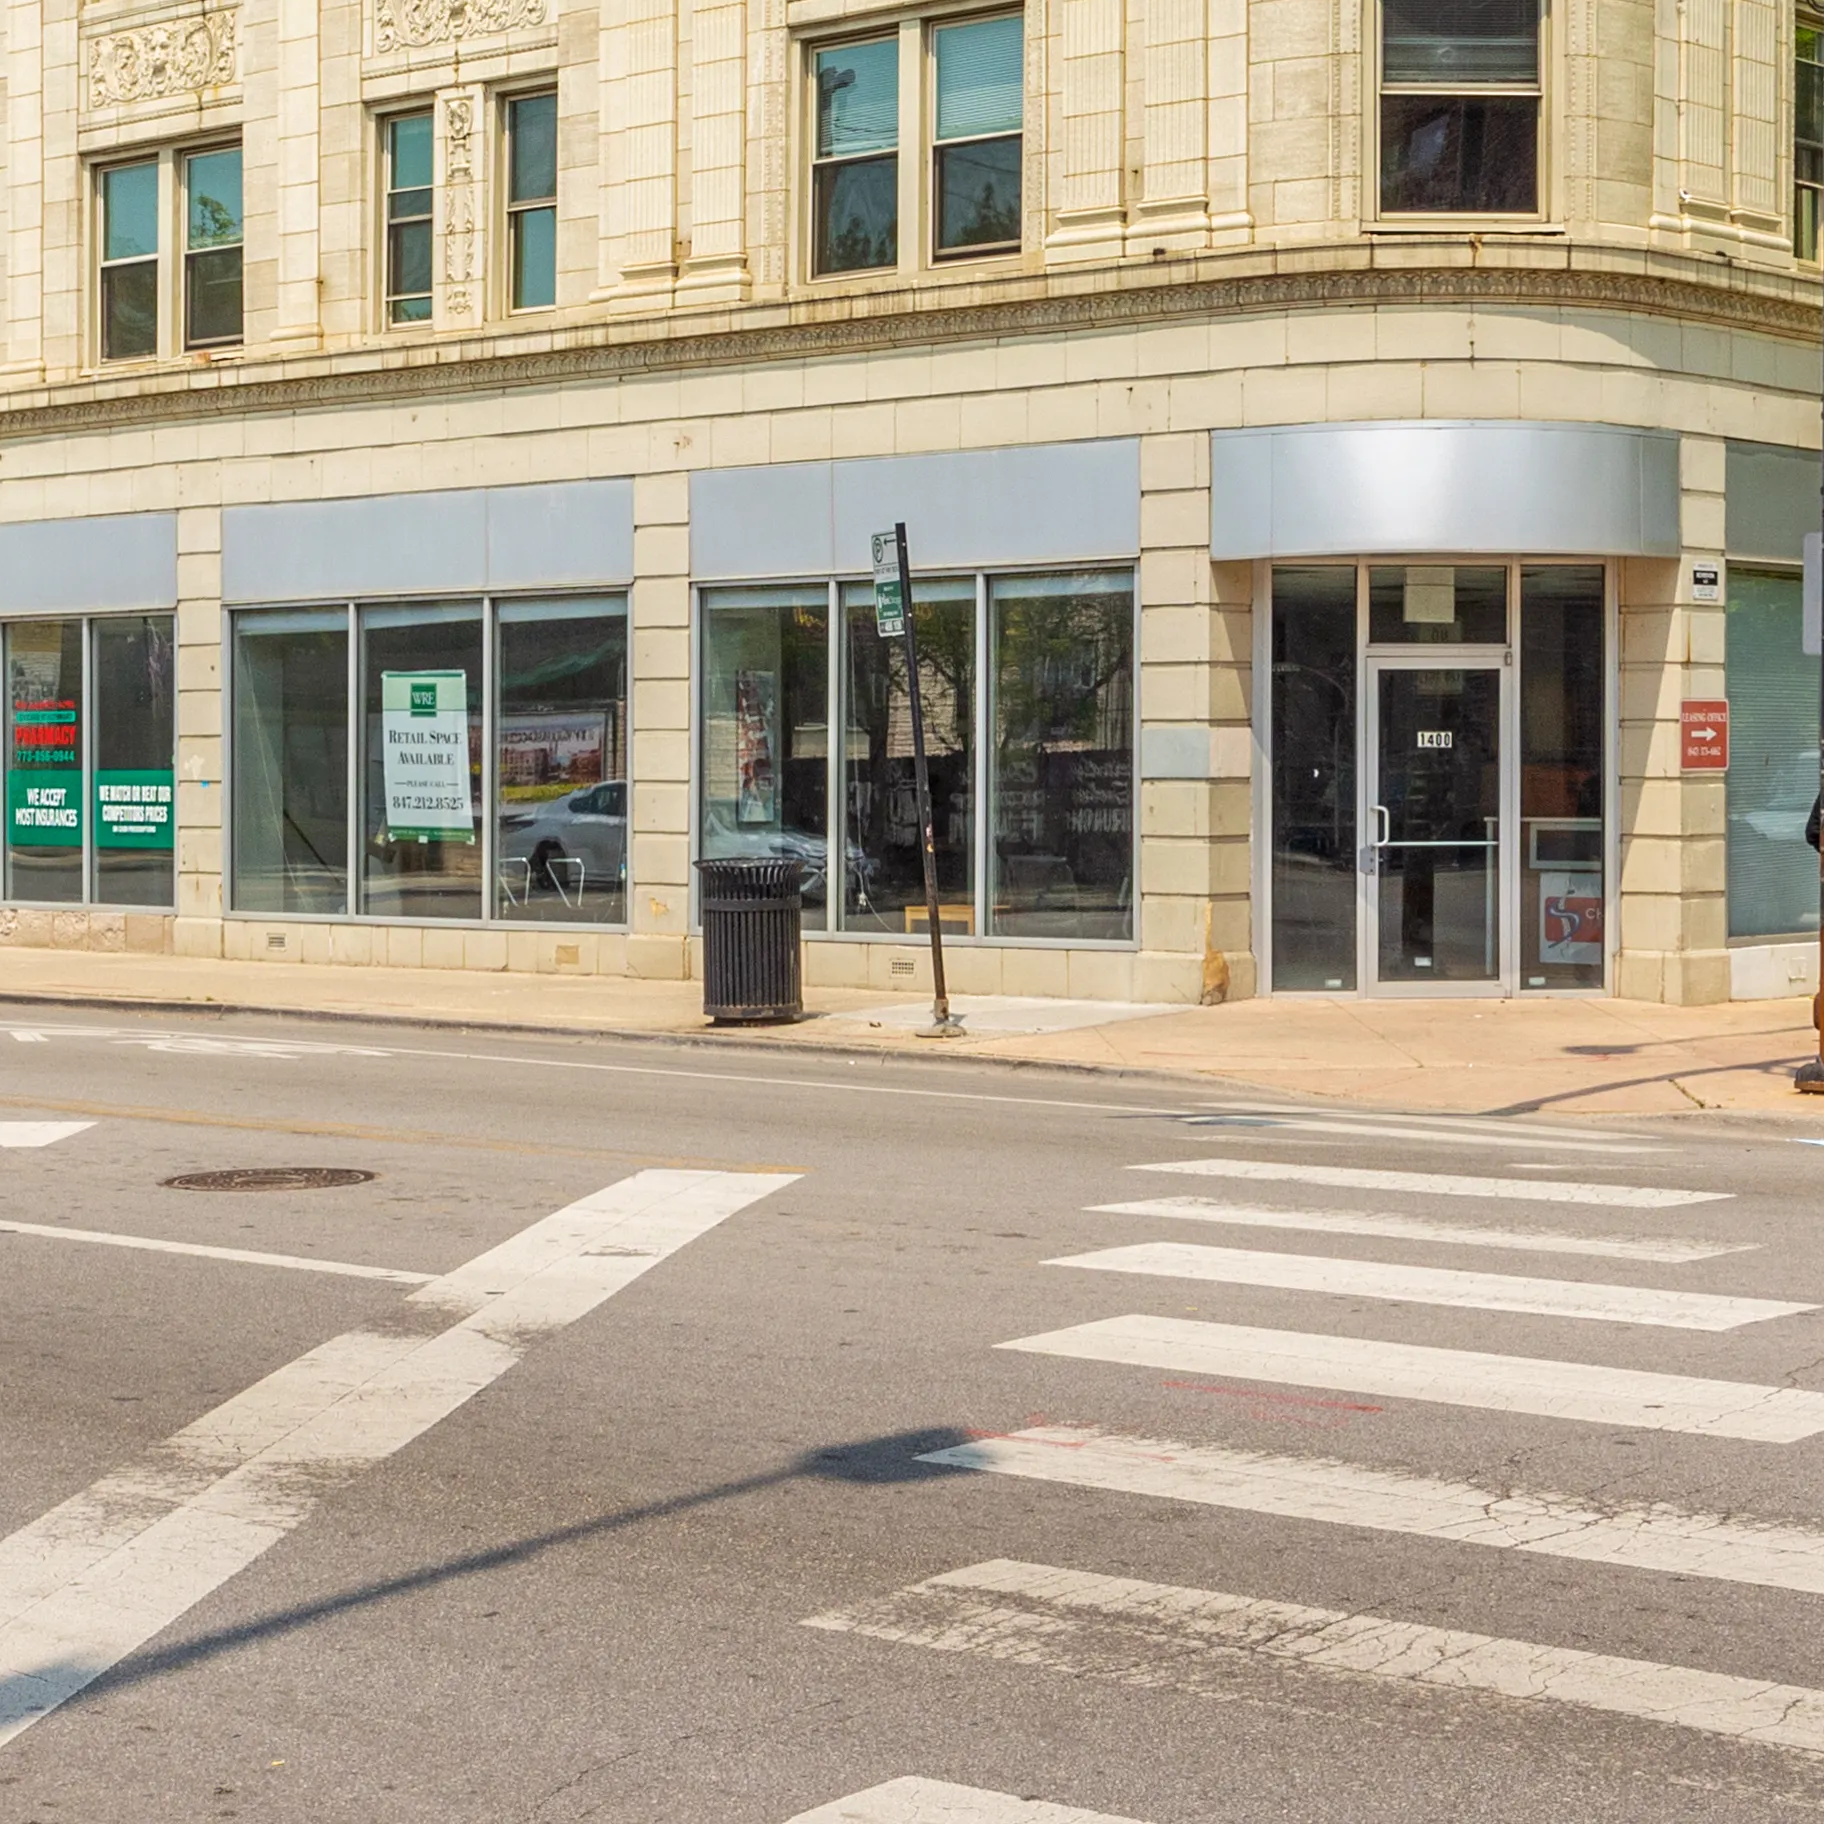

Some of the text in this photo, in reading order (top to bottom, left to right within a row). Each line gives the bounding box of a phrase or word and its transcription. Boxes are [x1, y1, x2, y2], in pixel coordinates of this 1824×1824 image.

[412, 691, 434, 705] WRE
[15, 727, 75, 745] PHARMACY
[389, 730, 461, 745] RETAIL SPACE
[1420, 733, 1450, 747] 1400
[398, 751, 454, 765] AVAILABLE
[27, 788, 66, 807] WE ACCEPT
[393, 796, 464, 810] 847.212.8525
[15, 808, 78, 827] MOST INSURANCES
